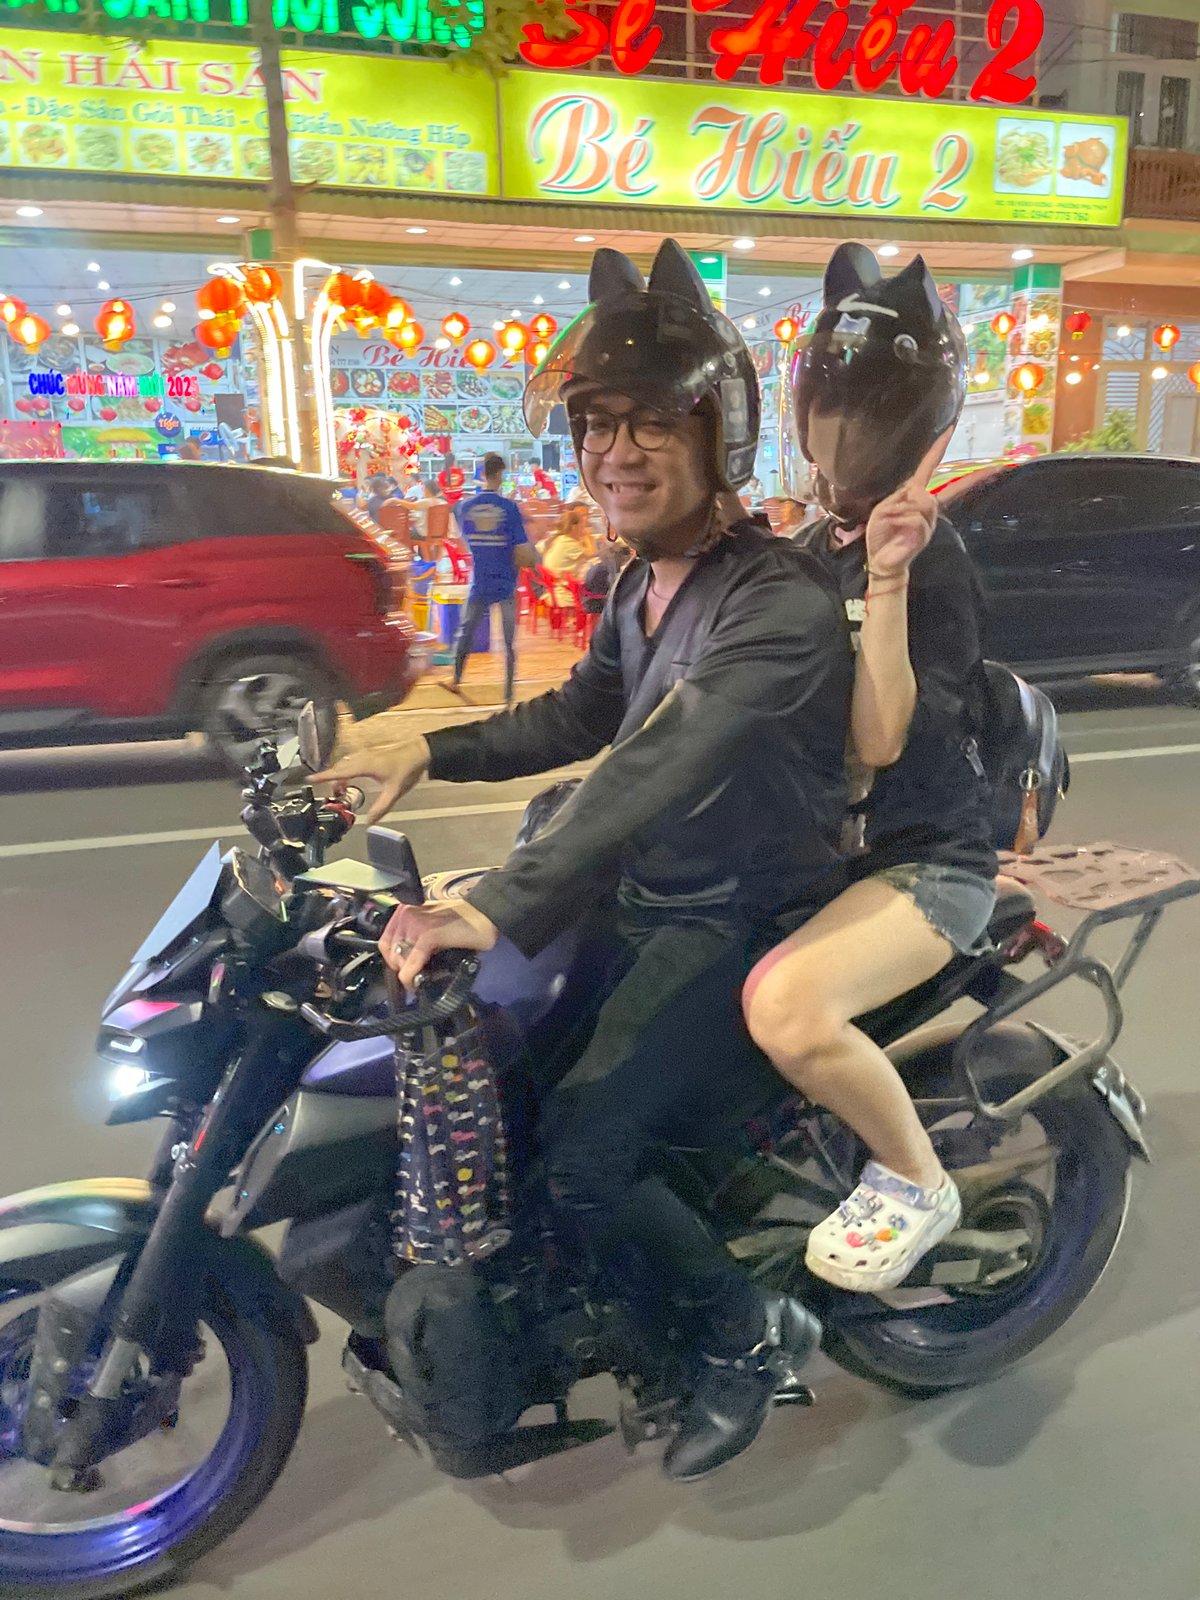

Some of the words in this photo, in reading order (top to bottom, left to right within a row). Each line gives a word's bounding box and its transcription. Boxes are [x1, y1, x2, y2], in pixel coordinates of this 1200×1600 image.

[60, 39, 183, 93] HẢI
[966, 0, 1044, 104] 2
[26, 95, 75, 122] Đặc
[530, 94, 658, 196] Bé
[689, 104, 902, 206] Hiếu
[921, 132, 973, 213] 2
[28, 368, 65, 396] CHÚC
